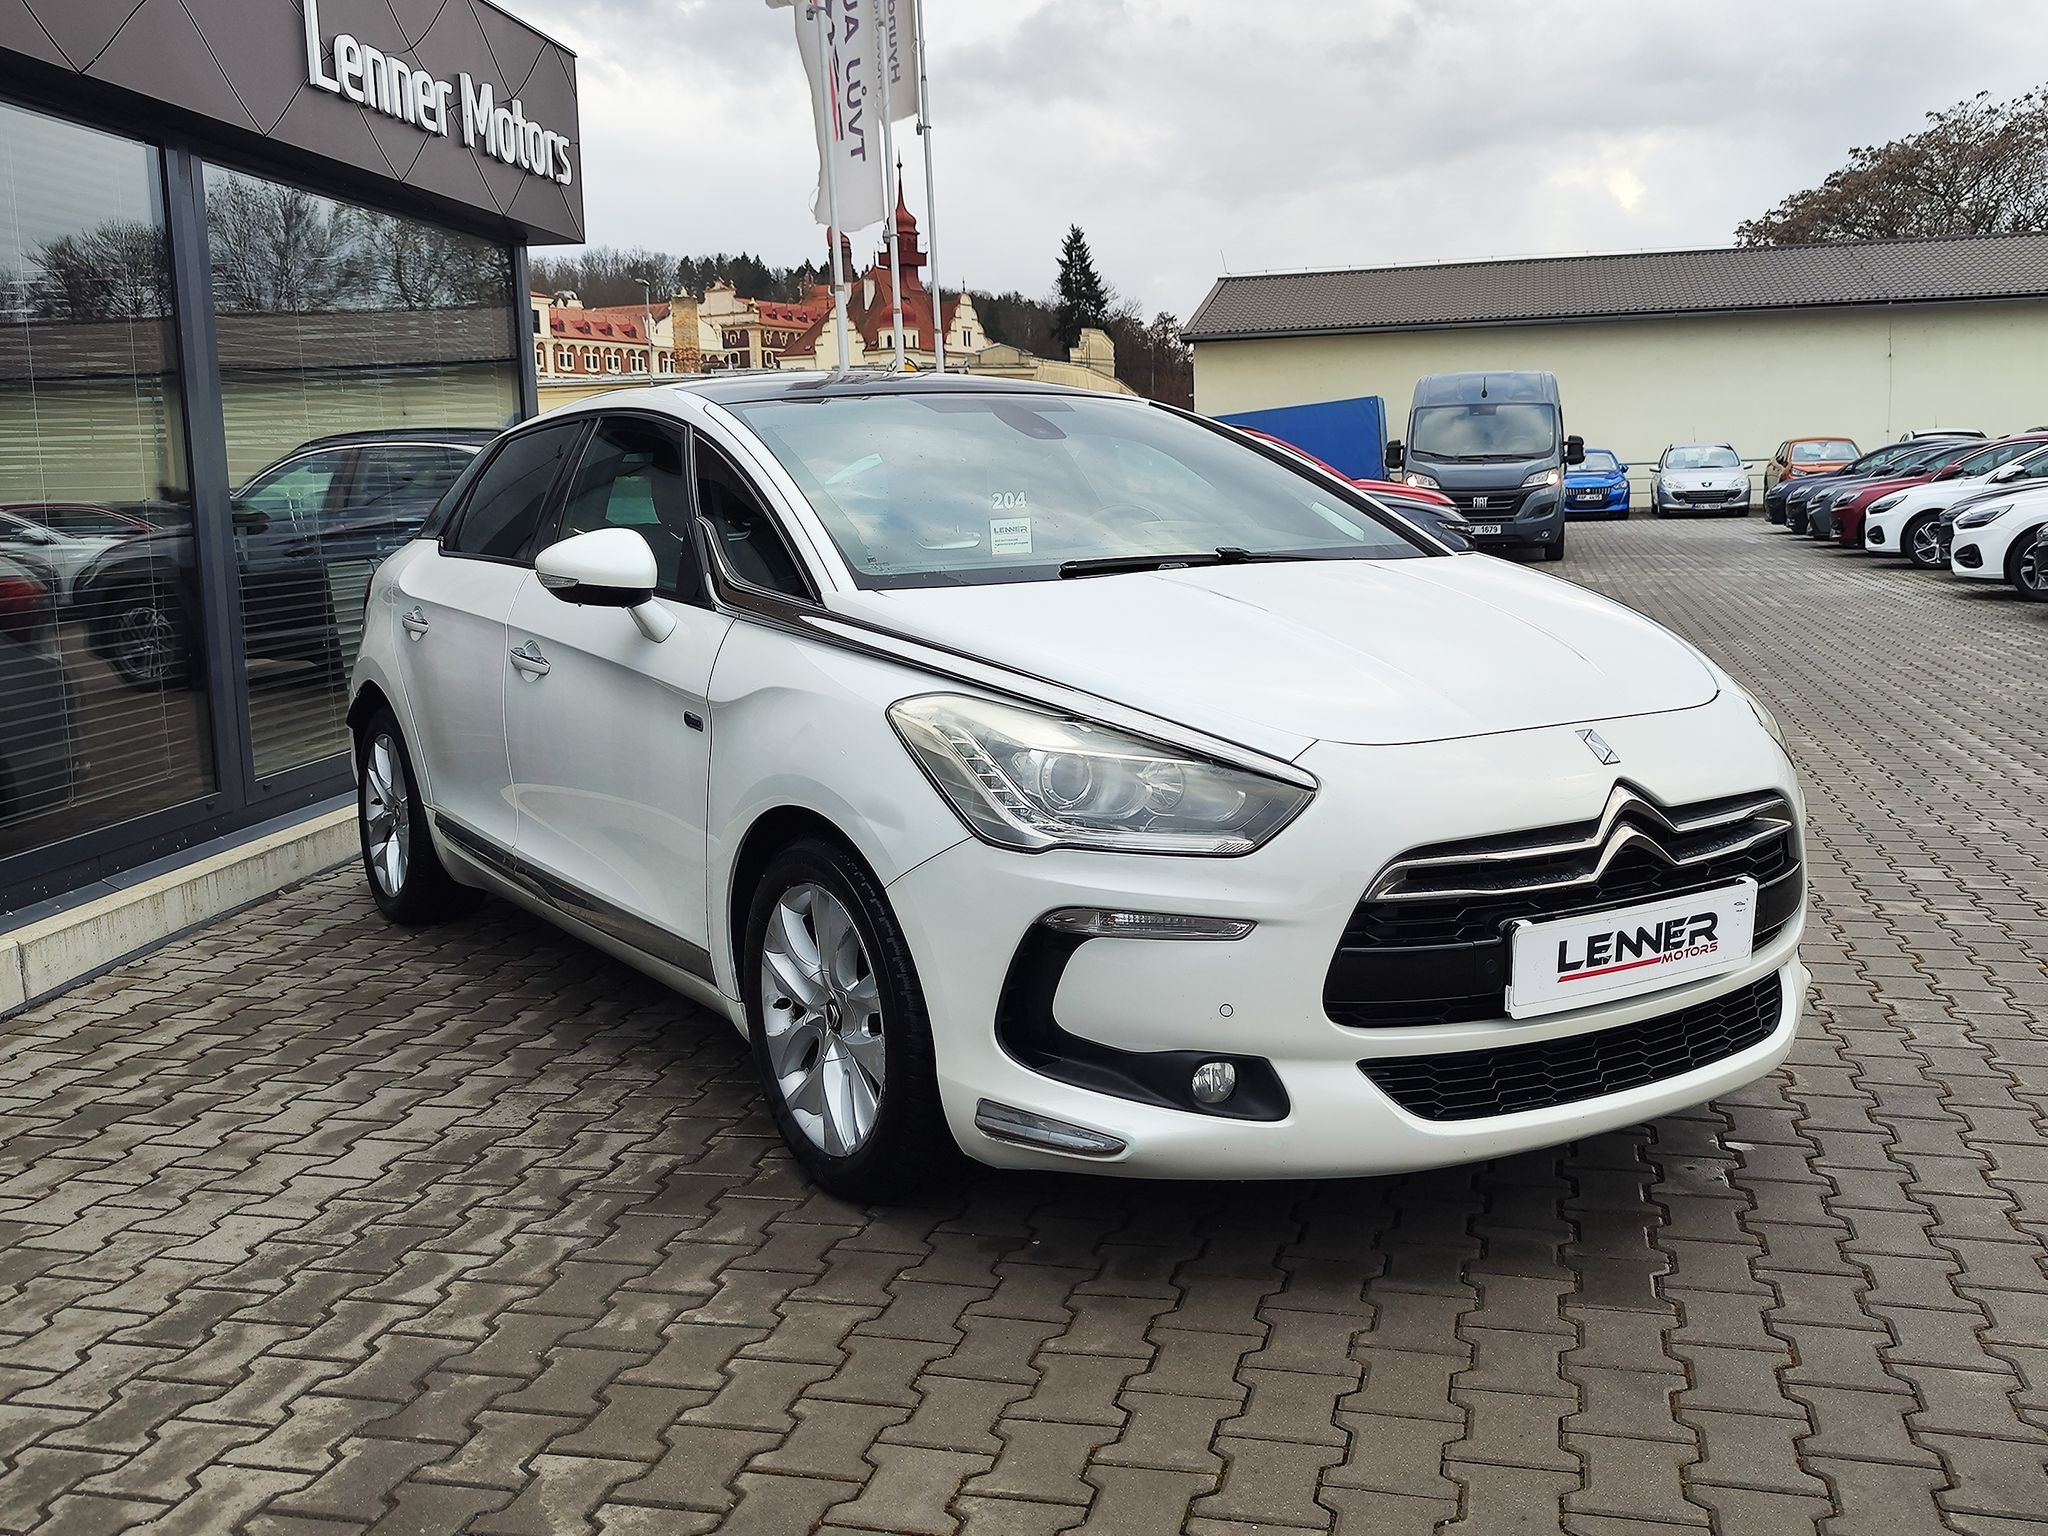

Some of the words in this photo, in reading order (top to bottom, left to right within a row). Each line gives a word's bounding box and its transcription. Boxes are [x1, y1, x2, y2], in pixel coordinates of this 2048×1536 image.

[303, 0, 453, 138] Lenner
[458, 72, 573, 186] Motors
[992, 491, 1027, 510] 204
[1473, 496, 1488, 508] FIAT
[1557, 911, 1718, 973] LENNER
[1661, 941, 1718, 964] MOTORS
